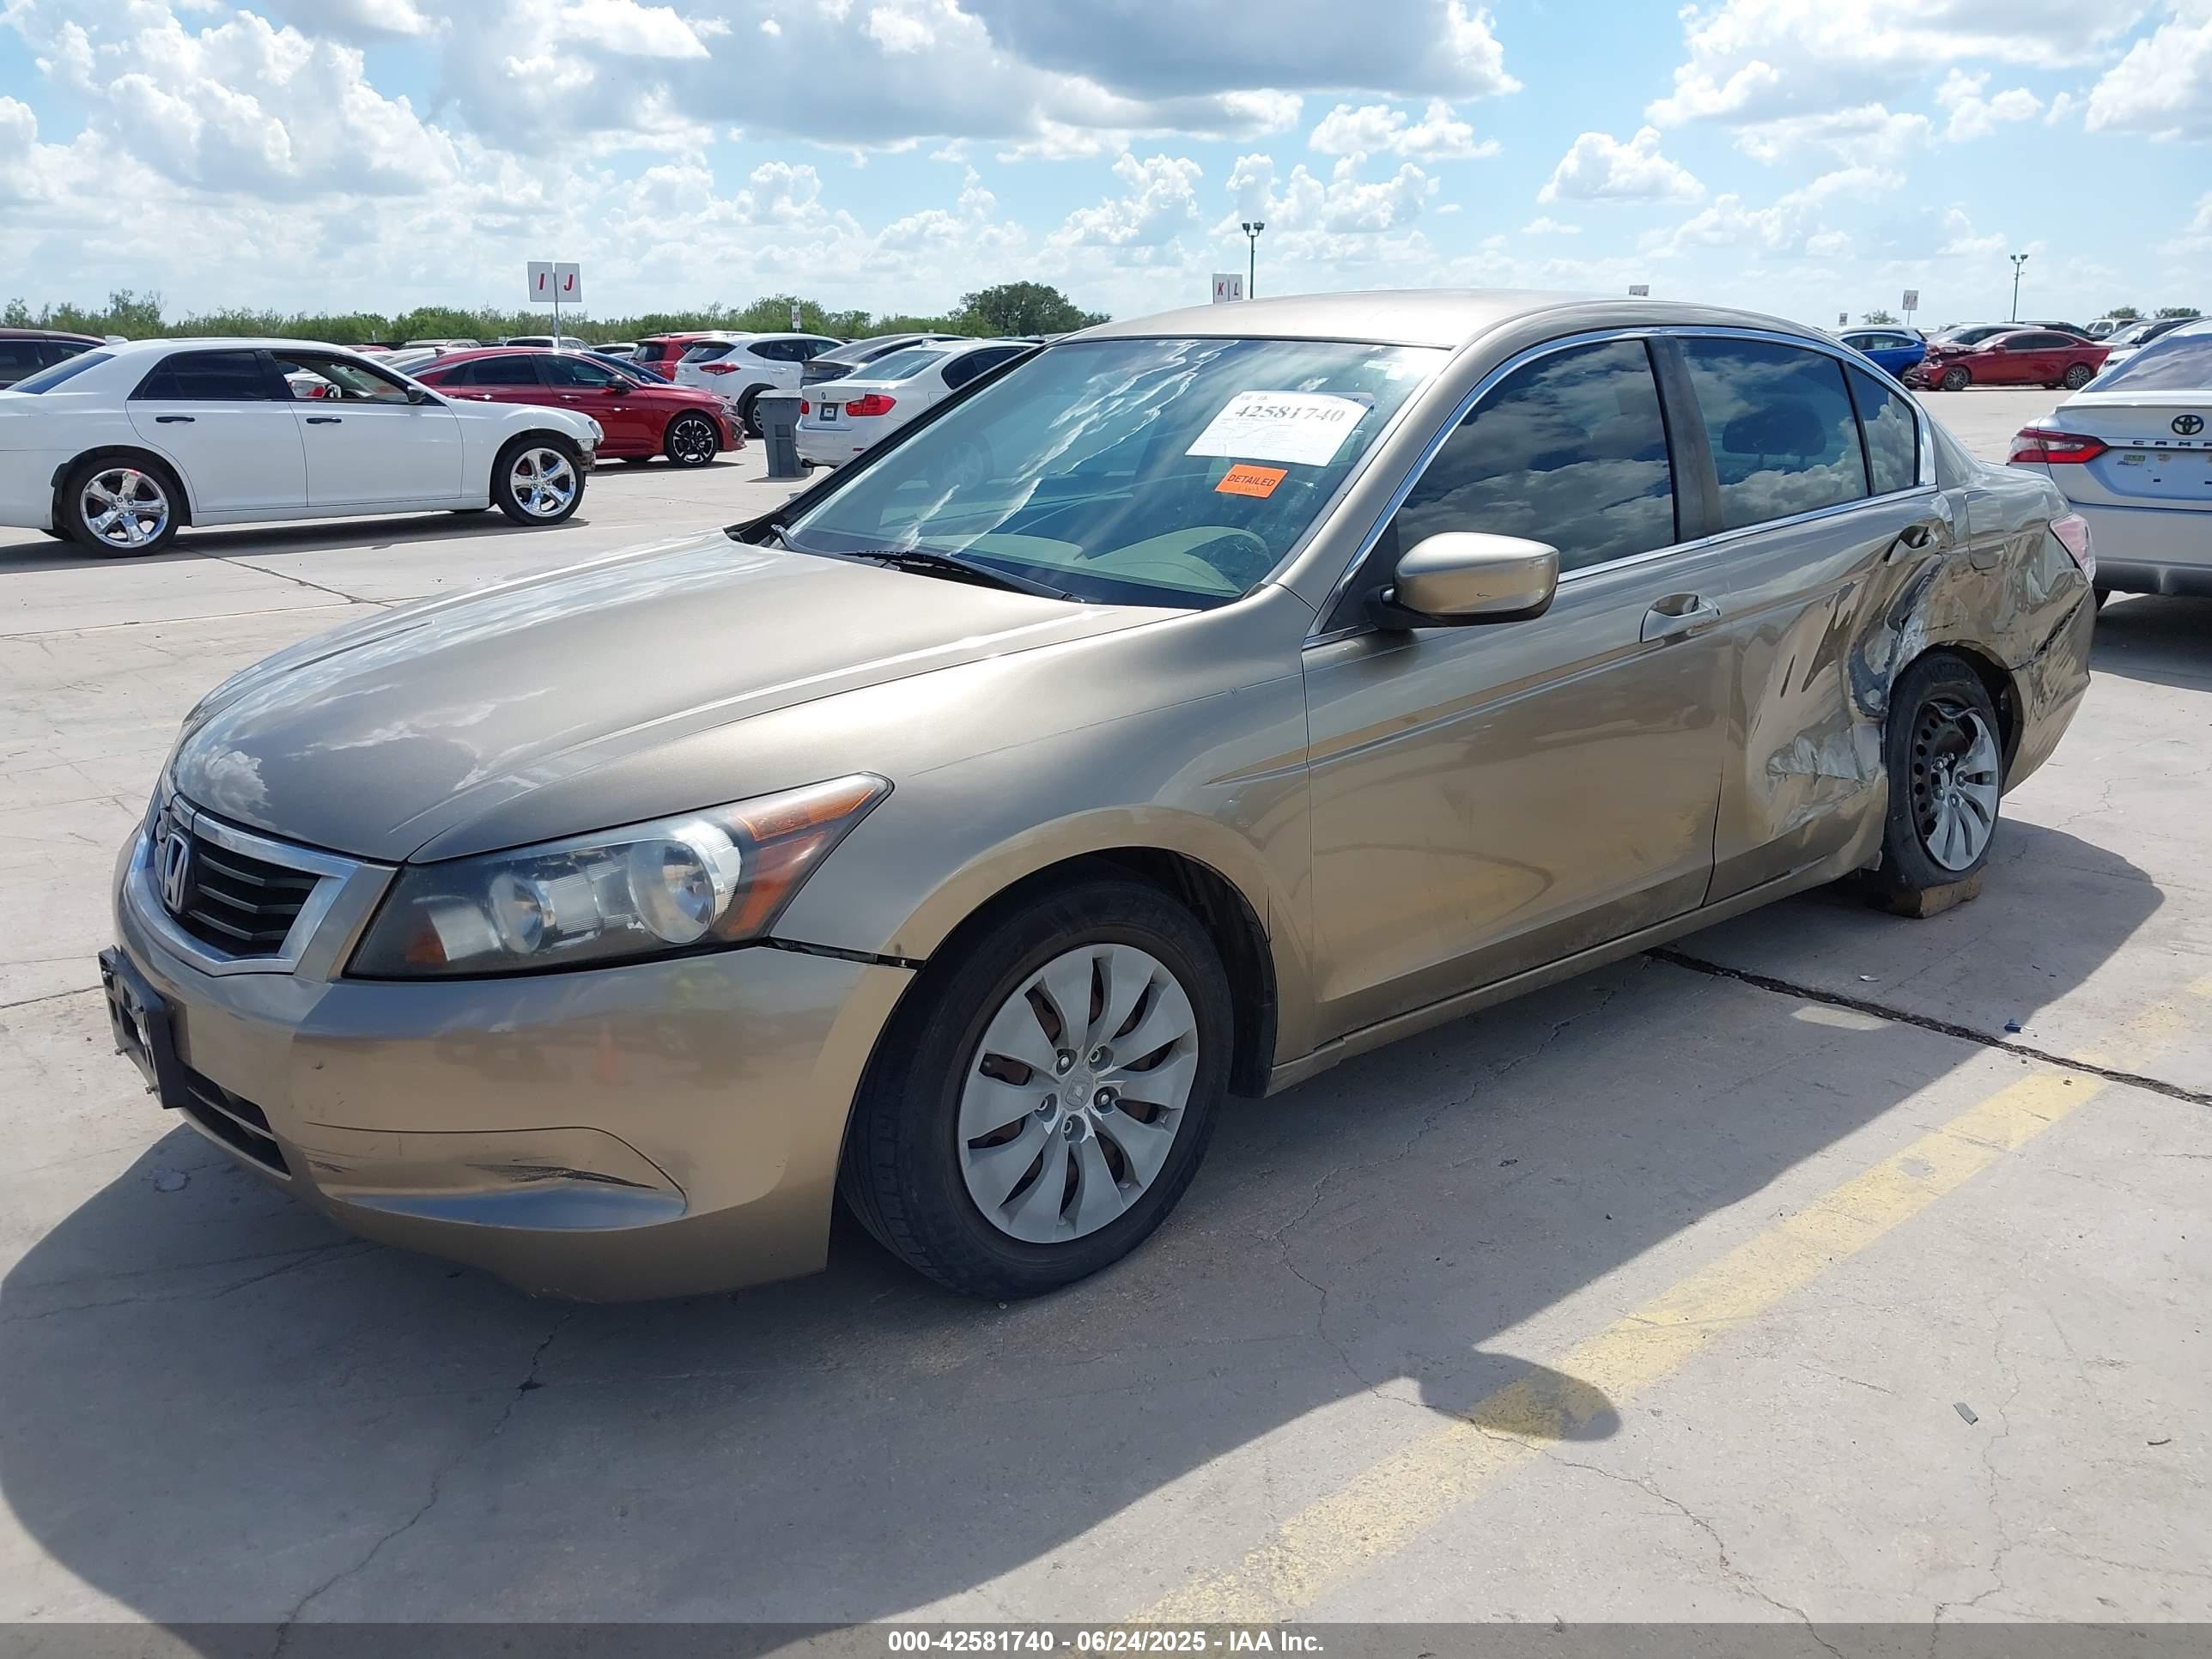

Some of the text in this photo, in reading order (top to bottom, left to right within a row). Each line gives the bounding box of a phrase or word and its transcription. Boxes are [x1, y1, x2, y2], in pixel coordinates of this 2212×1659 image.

[538, 273, 545, 290] I
[563, 274, 574, 291] J
[1217, 283, 1224, 295] K
[1233, 283, 1239, 295] L
[1235, 405, 1346, 422] 42581740
[1227, 474, 1276, 487] DETAILED
